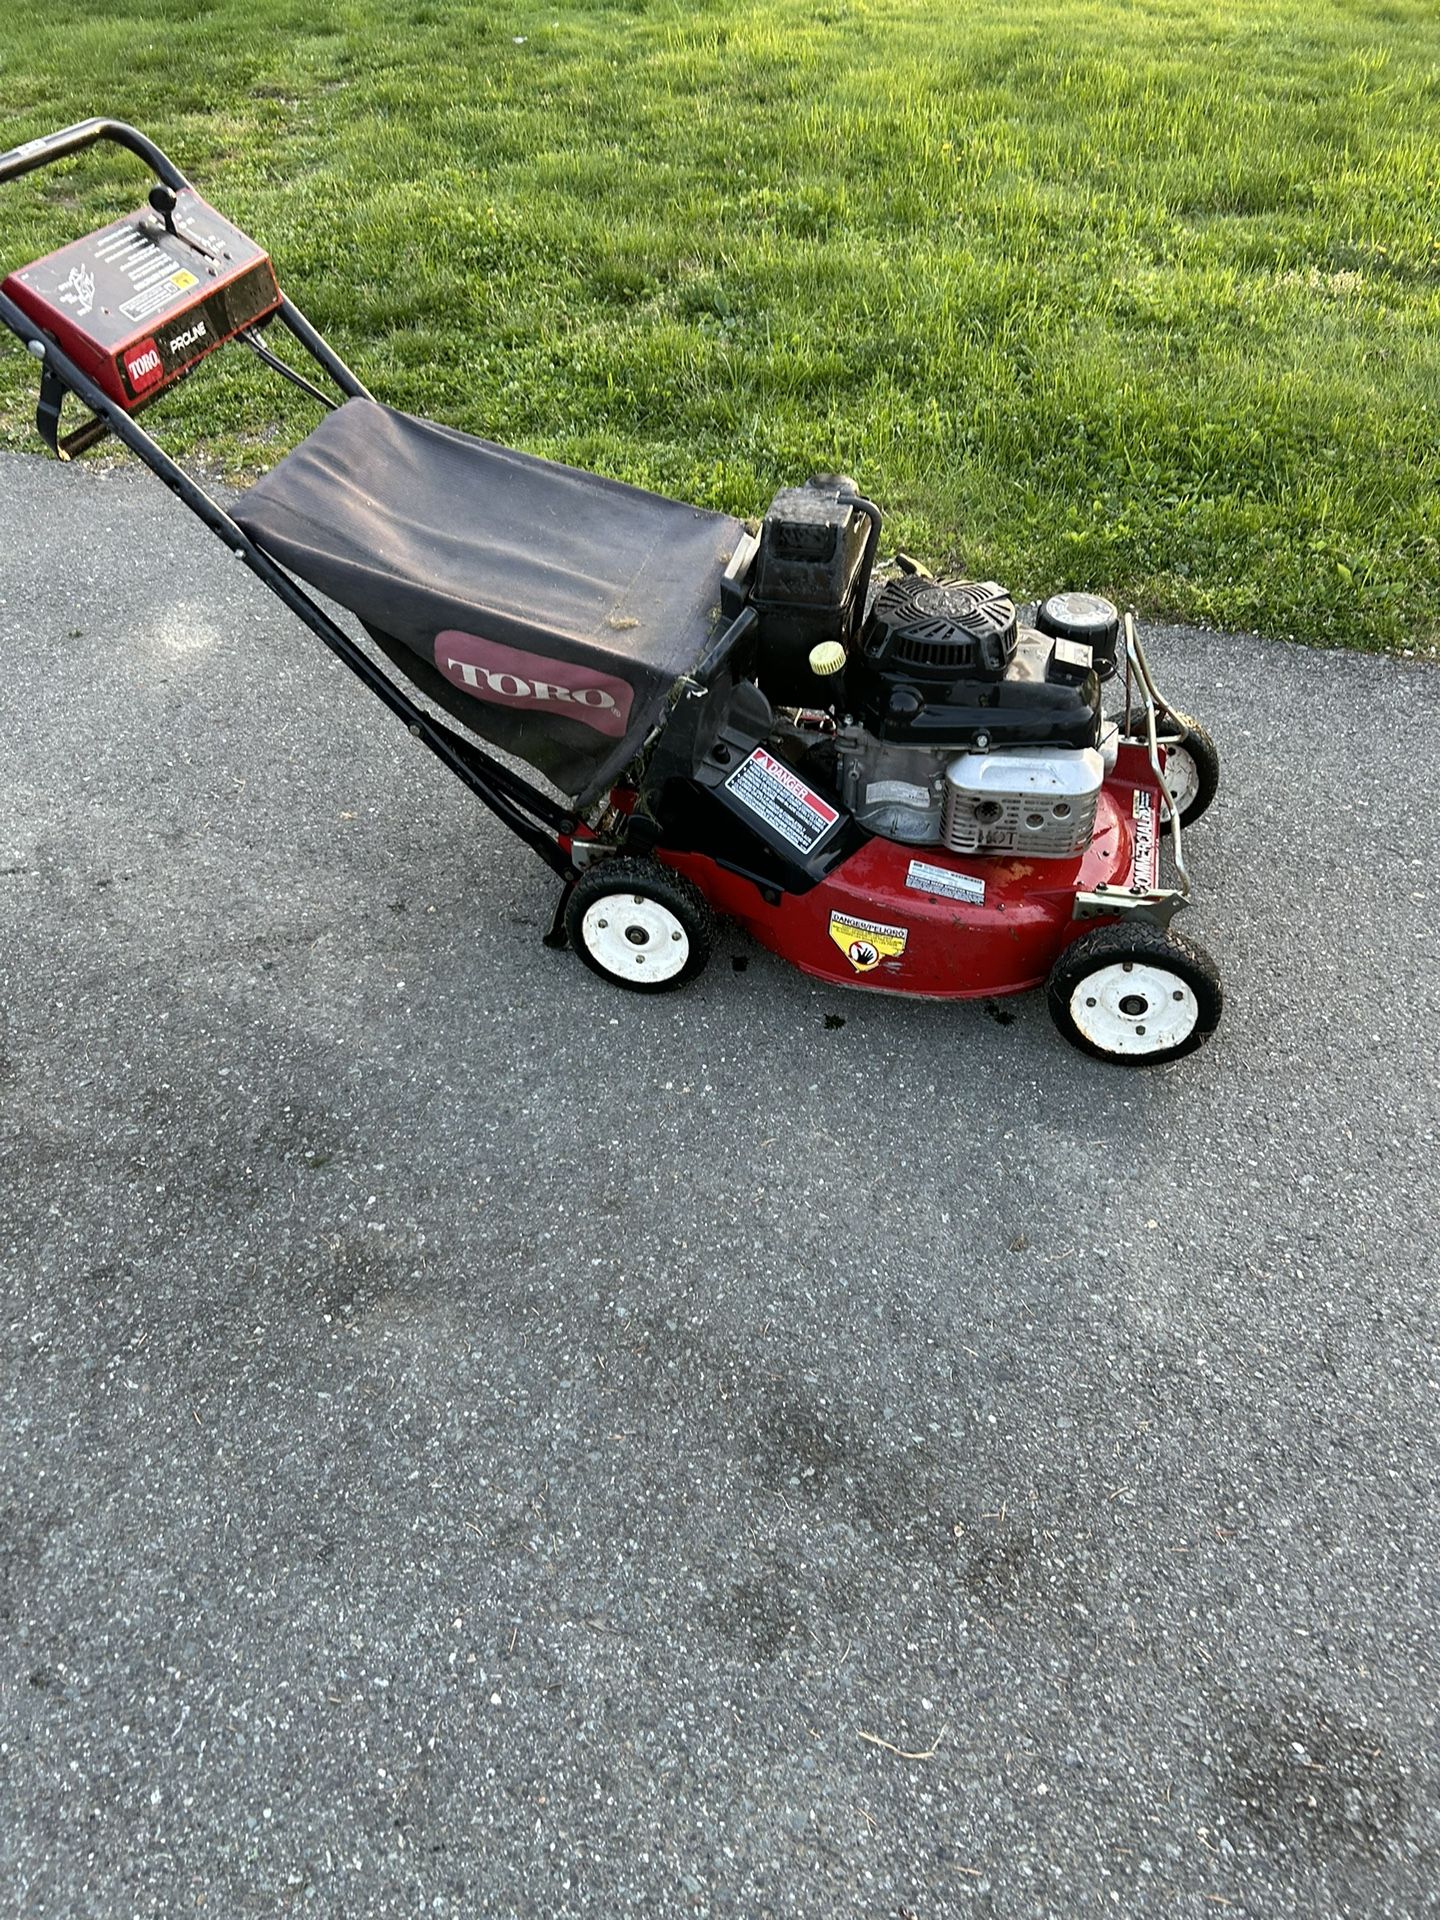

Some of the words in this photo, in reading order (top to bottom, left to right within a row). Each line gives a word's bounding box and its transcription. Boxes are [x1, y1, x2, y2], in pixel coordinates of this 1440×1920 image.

[170, 321, 206, 354] PROLINE
[128, 349, 159, 380] TORO
[447, 658, 615, 708] TORO
[768, 763, 809, 800] DANGER
